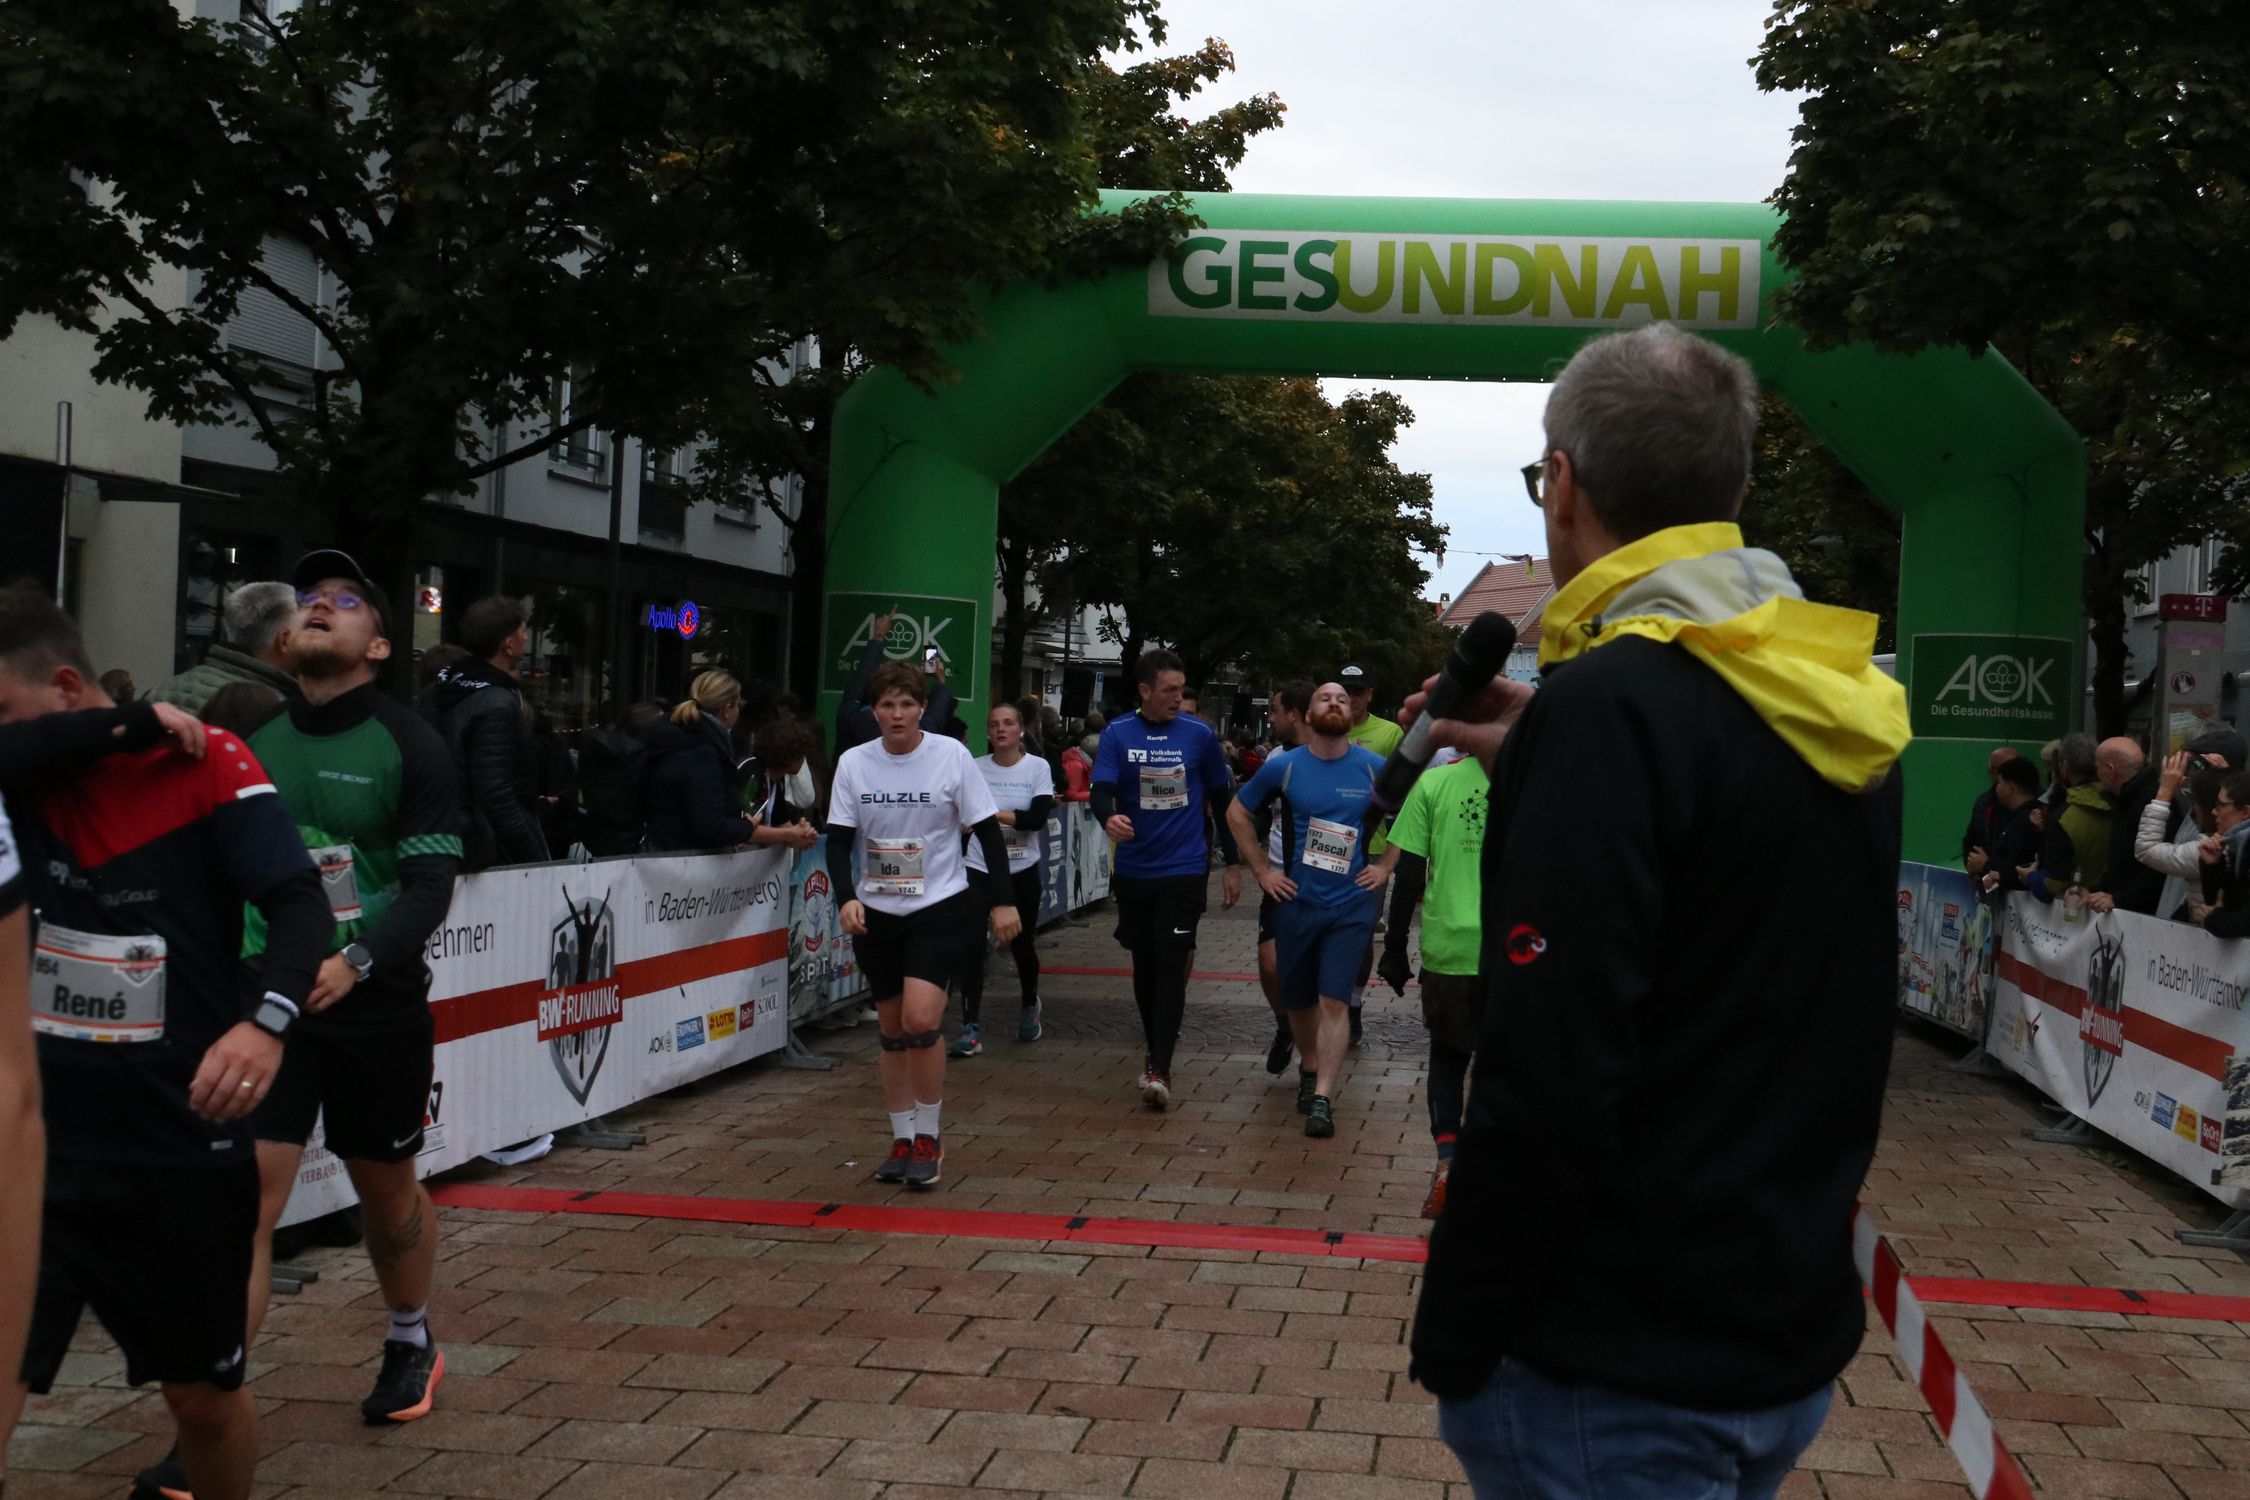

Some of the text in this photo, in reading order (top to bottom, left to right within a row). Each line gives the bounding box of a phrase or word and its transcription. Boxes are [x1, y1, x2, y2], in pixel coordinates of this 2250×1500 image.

[1167, 236, 1741, 321] GESUNDNAH
[649, 604, 677, 631] Apollo
[841, 611, 953, 662] AOK
[1935, 654, 2055, 705] AOK
[1931, 704, 1948, 716] Die
[861, 789, 931, 804] SÜLZLE
[1152, 785, 1175, 796] Nico
[1309, 829, 1323, 839] 1373
[1311, 838, 1347, 857] Pascal
[881, 862, 900, 876] Ida
[1331, 864, 1345, 873] 1373
[898, 886, 917, 894] 1742
[644, 891, 655, 924] in
[35, 956, 58, 977] 954
[2146, 950, 2156, 981] in
[53, 984, 126, 1020] René
[539, 984, 620, 1032] BW-RUNNING
[648, 1035, 665, 1054] AOK
[714, 1010, 736, 1029] LOTTO
